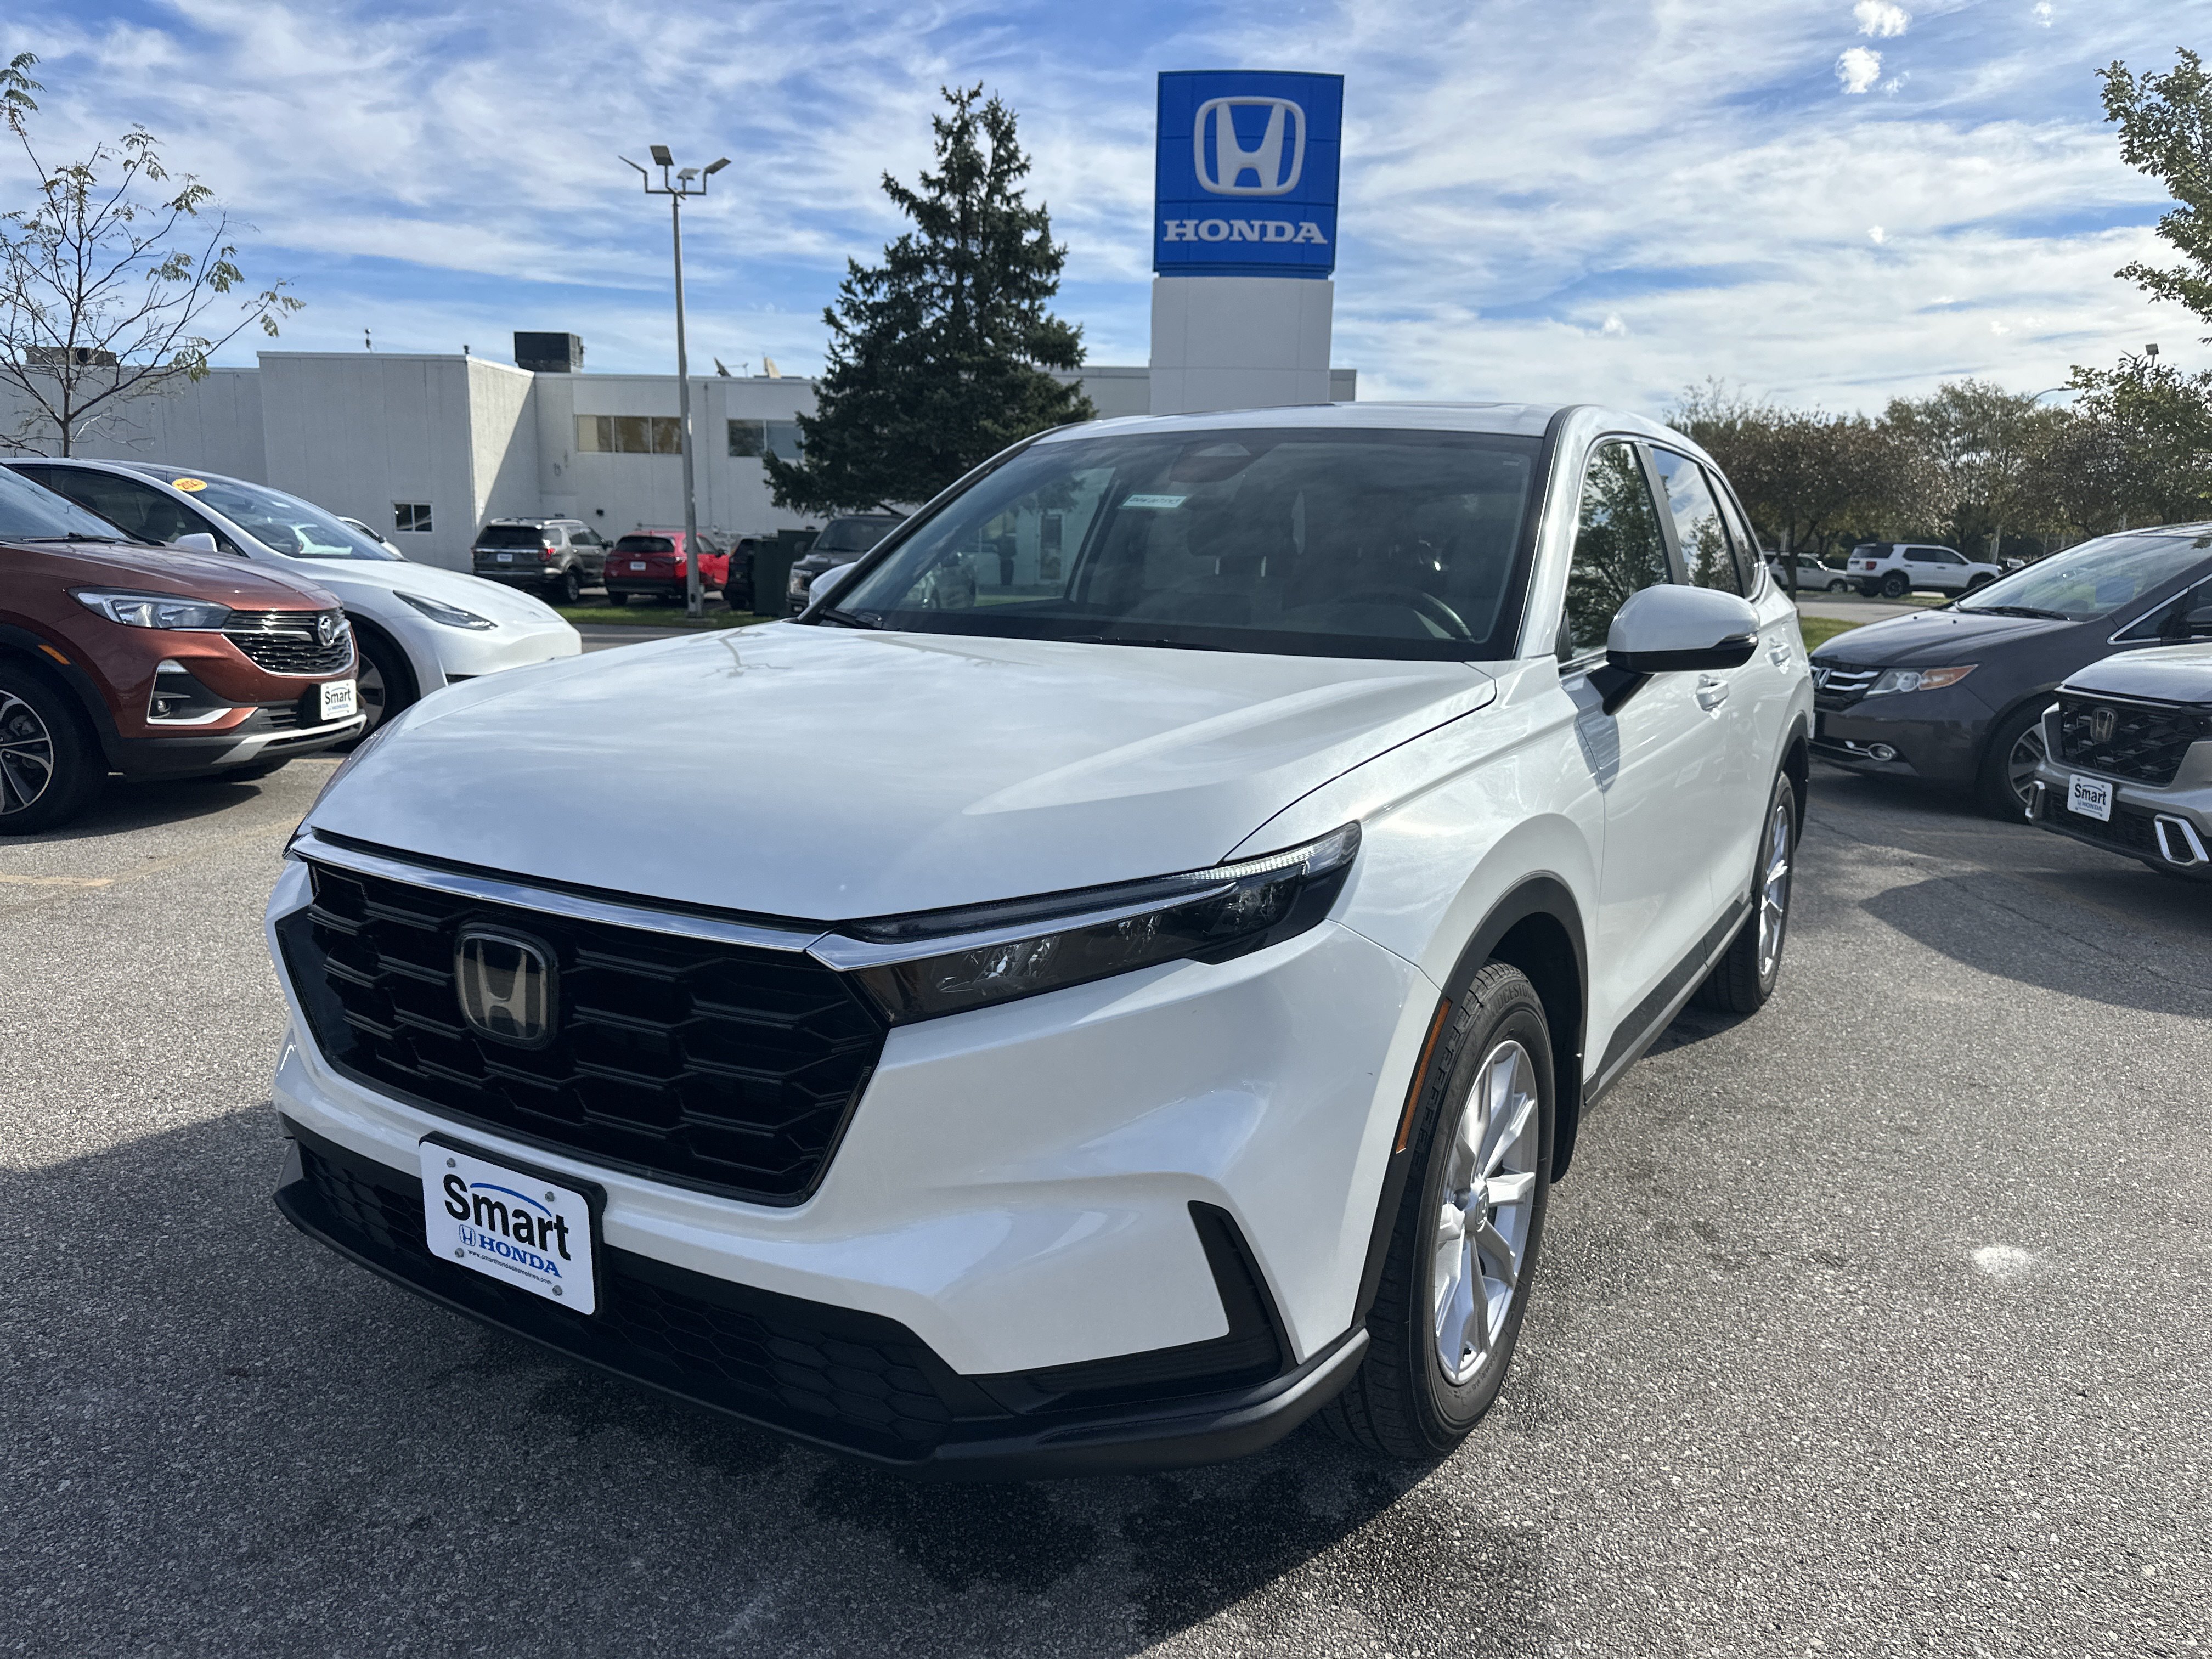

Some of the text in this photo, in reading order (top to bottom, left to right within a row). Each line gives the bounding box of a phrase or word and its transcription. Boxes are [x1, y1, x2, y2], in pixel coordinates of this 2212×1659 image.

[1163, 219, 1328, 245] HONDA
[325, 689, 351, 705] Smart
[2074, 783, 2107, 805] Smart
[443, 1173, 571, 1261] Smart
[467, 1250, 552, 1285] www.smarthondadesmoines.com
[478, 1233, 562, 1278] HONDA
